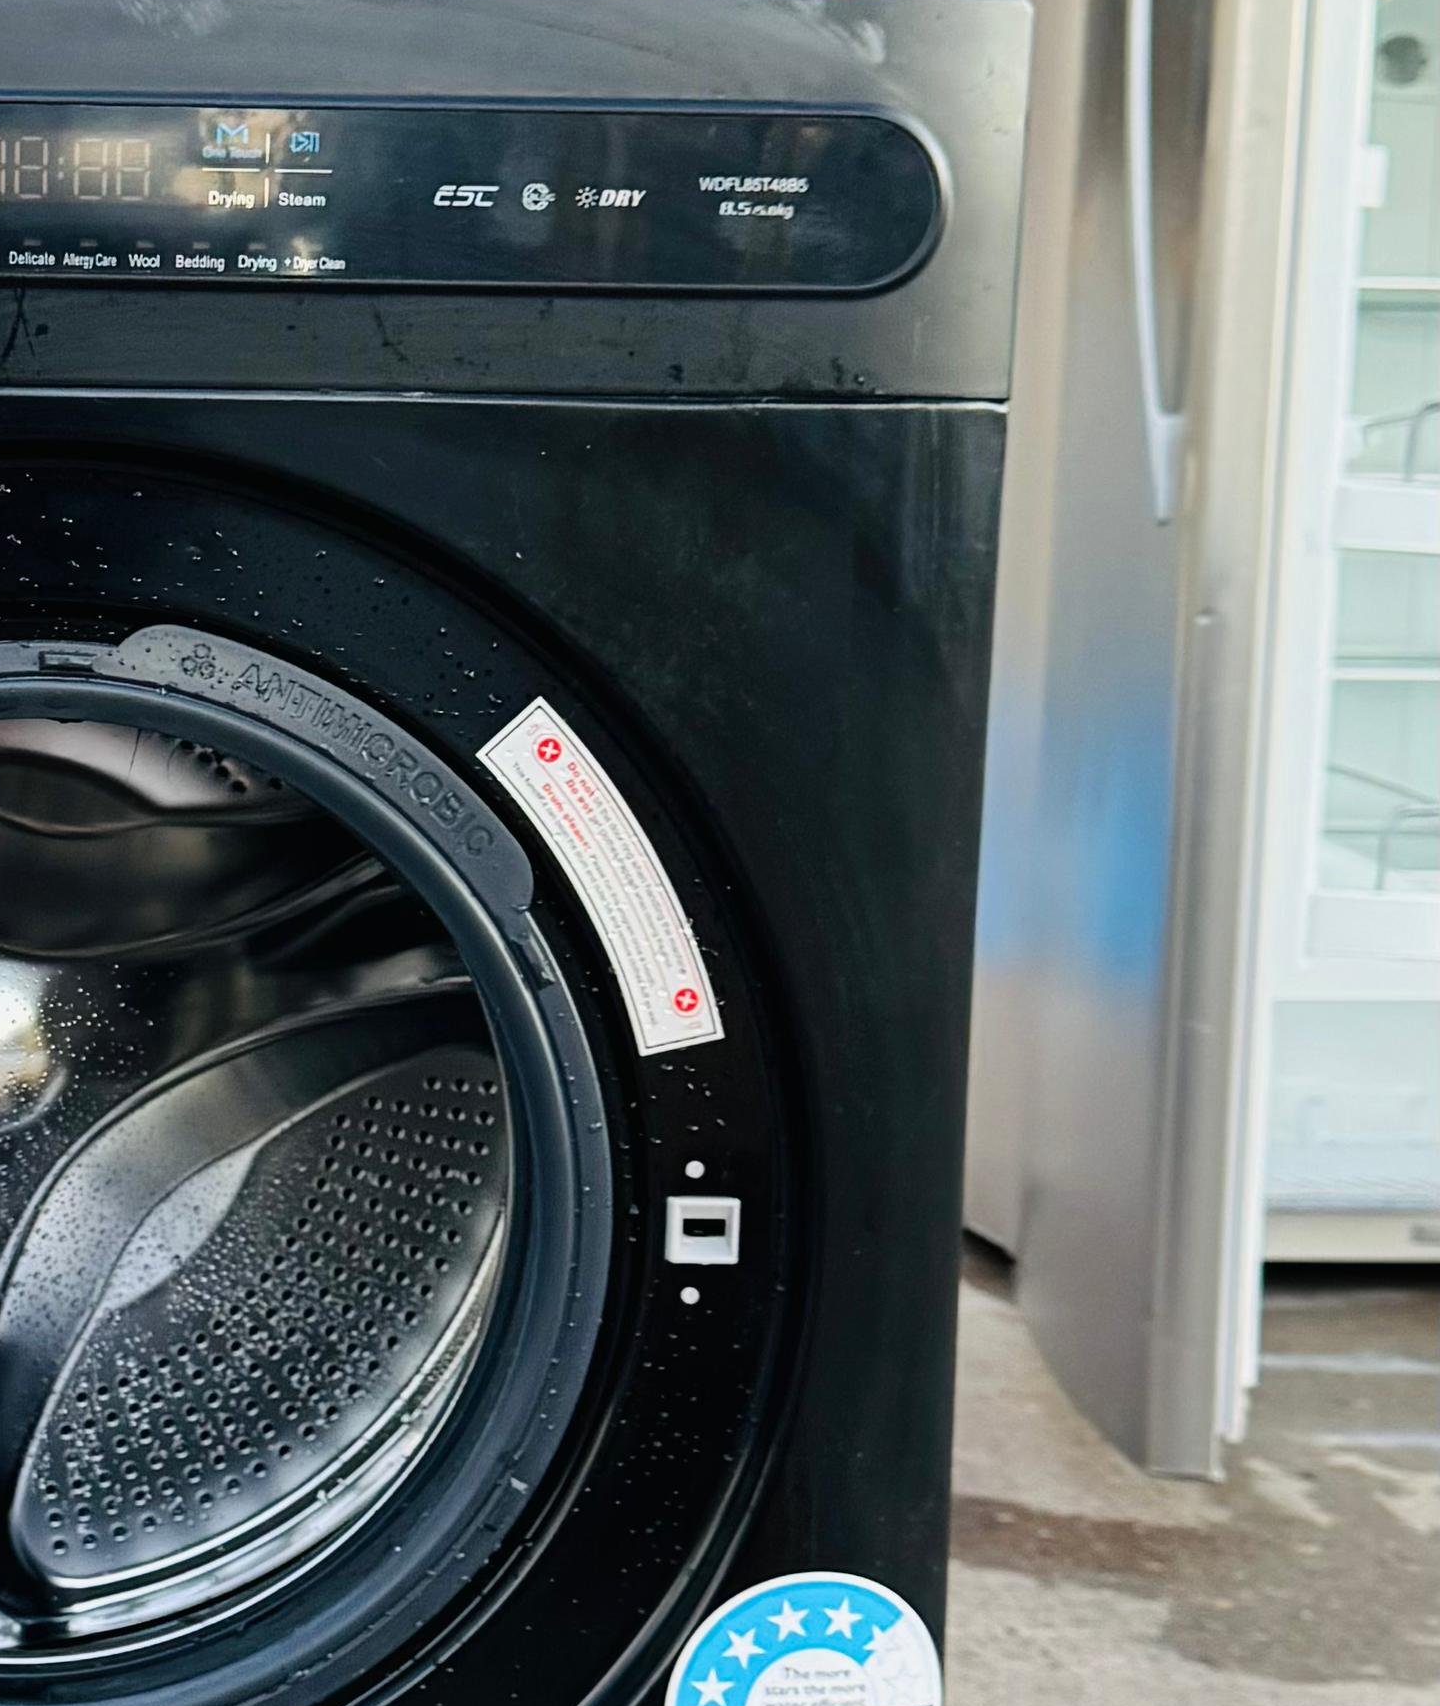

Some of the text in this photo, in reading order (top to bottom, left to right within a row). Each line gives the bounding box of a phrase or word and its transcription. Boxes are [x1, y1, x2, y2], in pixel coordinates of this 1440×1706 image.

[208, 190, 256, 208] Drying
[278, 192, 327, 207] Steam
[598, 189, 647, 208] DRY
[8, 251, 56, 266] Delicate
[63, 253, 118, 269] Allergy Care
[128, 254, 161, 268] Wool
[175, 254, 226, 272] Bedding
[237, 254, 278, 272] Drying
[566, 760, 582, 778] Do
[577, 777, 597, 798] not
